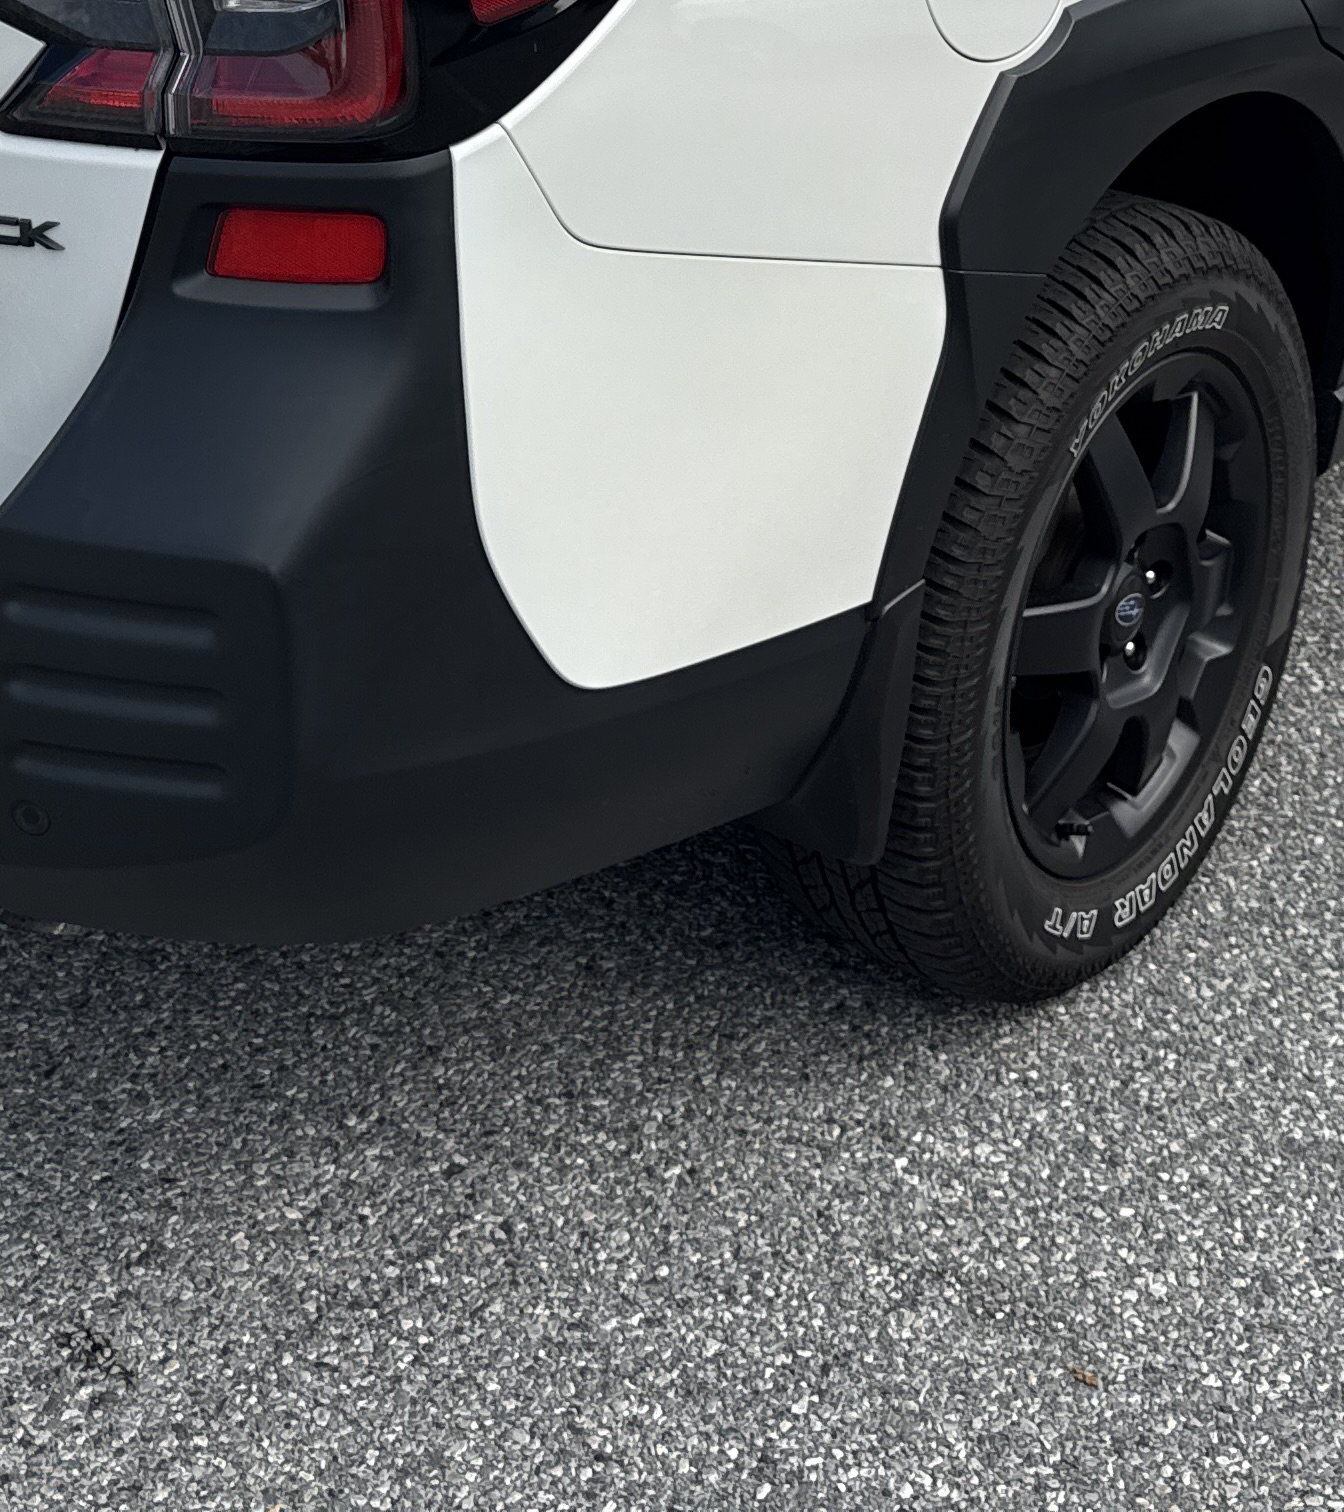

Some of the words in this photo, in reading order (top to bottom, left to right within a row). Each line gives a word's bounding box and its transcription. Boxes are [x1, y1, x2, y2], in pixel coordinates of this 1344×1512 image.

[1069, 305, 1229, 457] YOKOHAMA
[1113, 665, 1273, 928] GEOLANDAR
[1044, 906, 1098, 938] A/T
